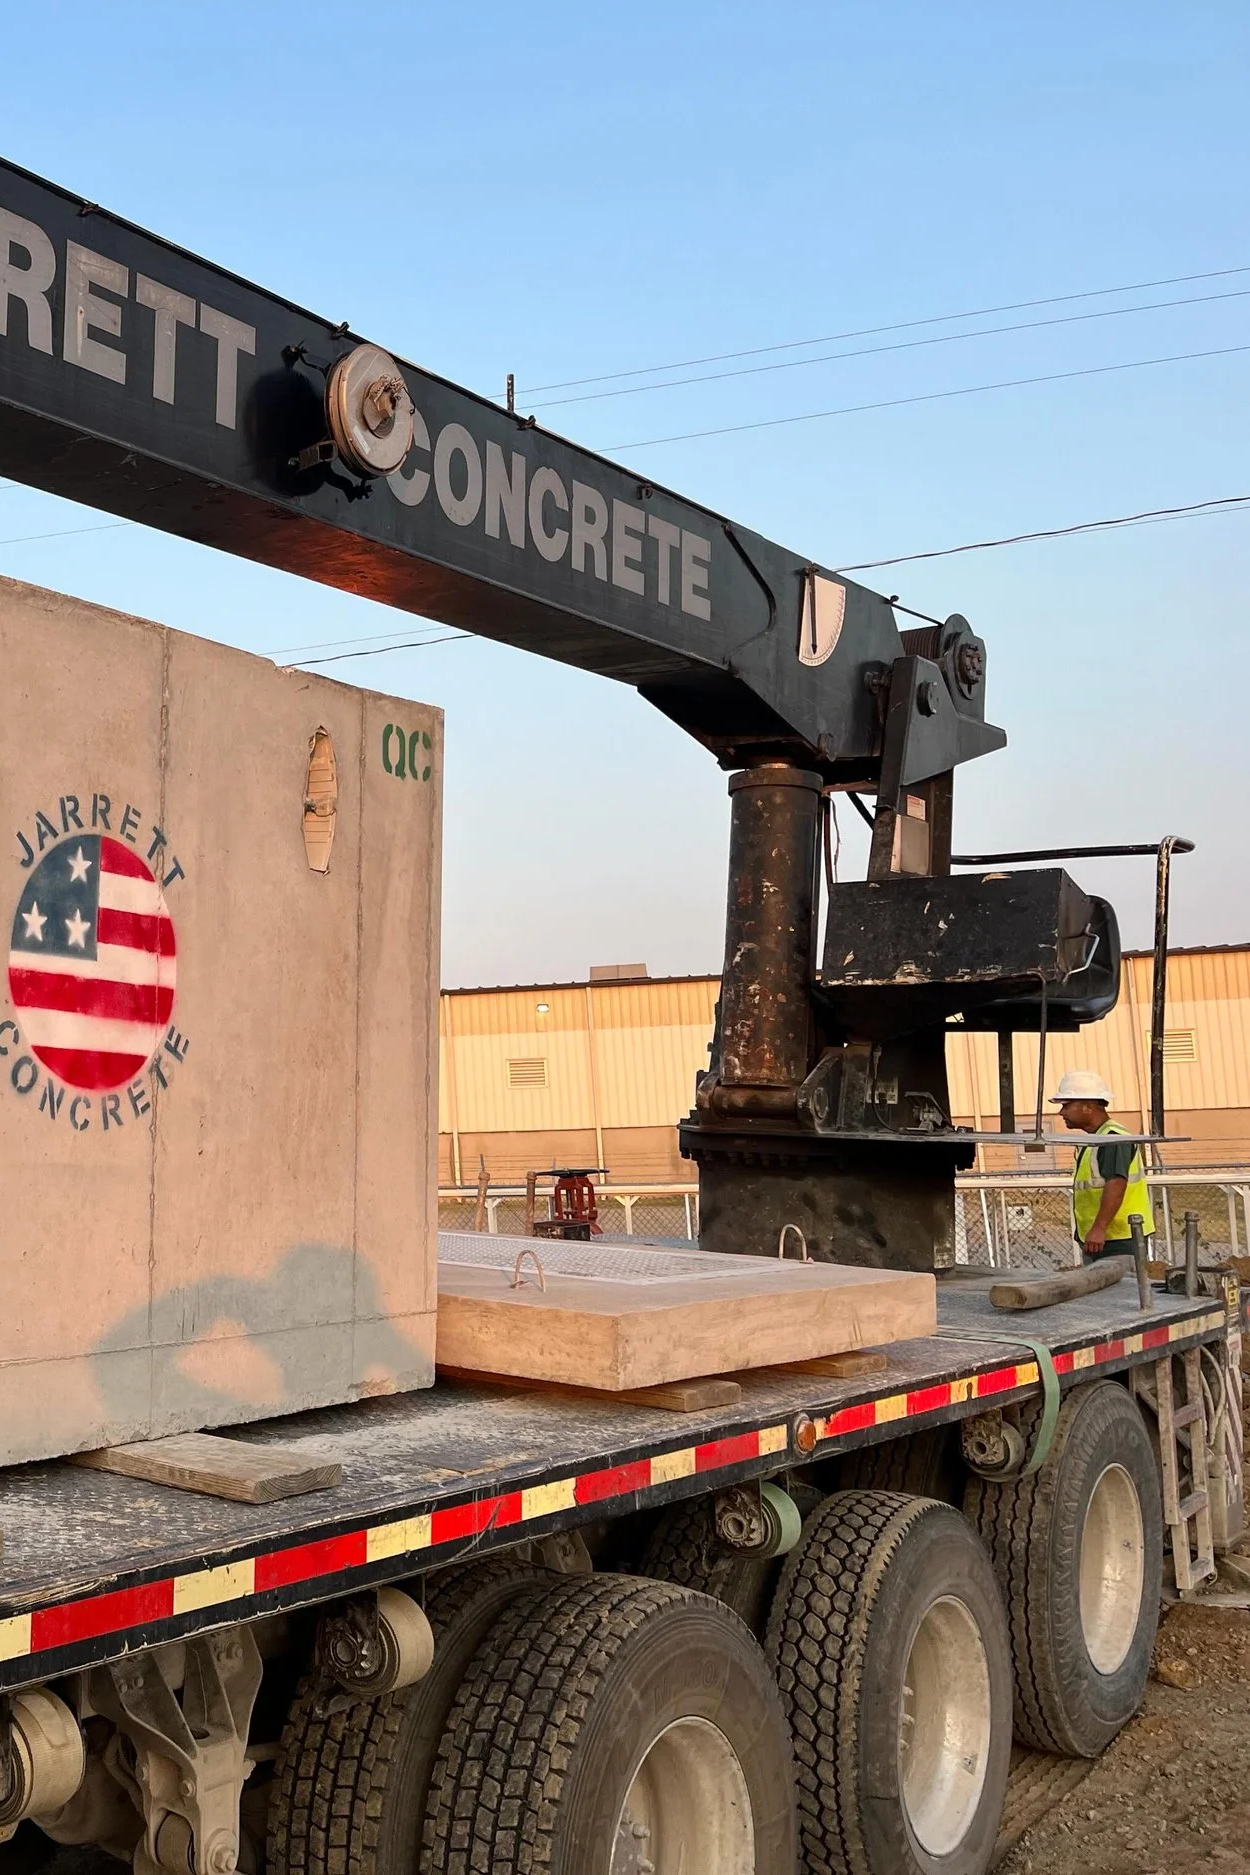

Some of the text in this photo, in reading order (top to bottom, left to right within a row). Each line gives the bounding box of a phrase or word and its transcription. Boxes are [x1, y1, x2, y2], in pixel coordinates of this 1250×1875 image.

[386, 409, 711, 621] CONCRETE
[382, 723, 432, 782] QC
[15, 793, 185, 888] JARRETT
